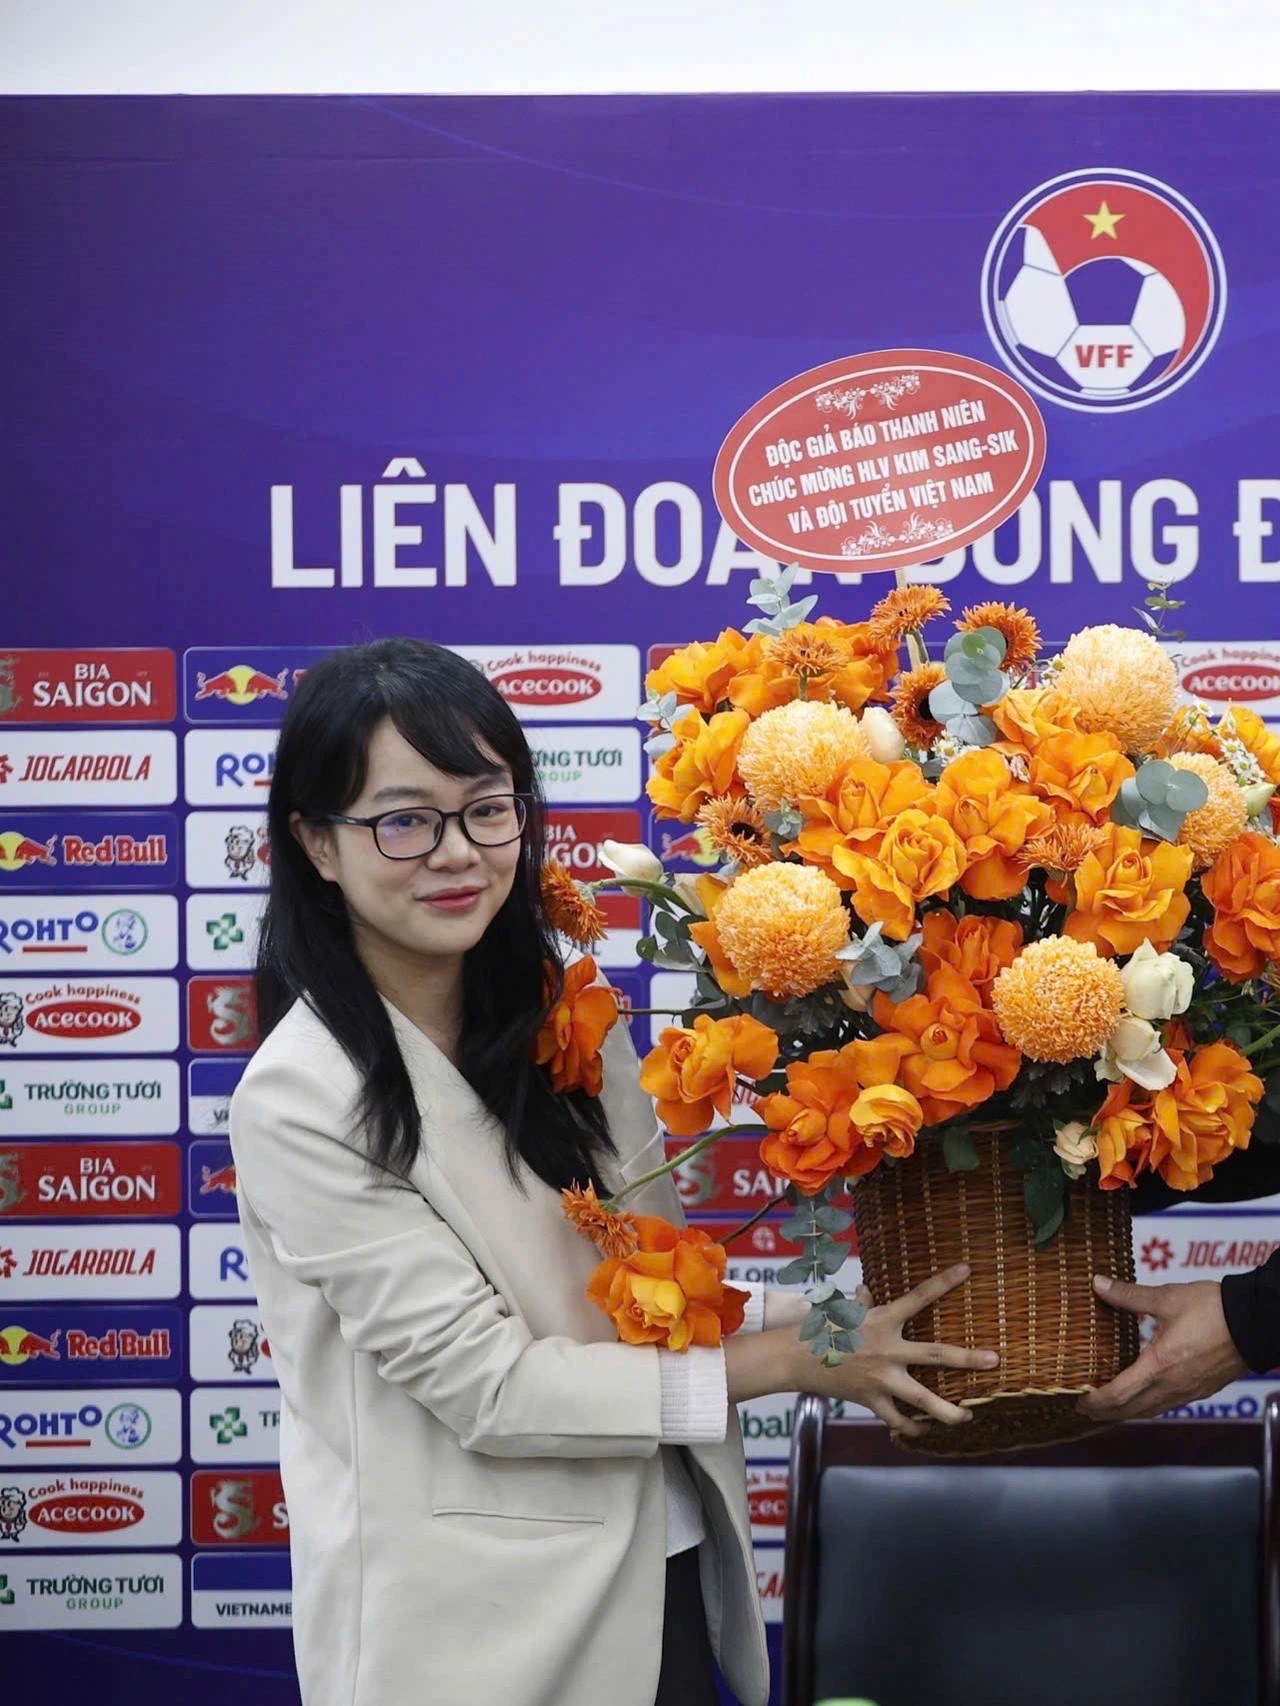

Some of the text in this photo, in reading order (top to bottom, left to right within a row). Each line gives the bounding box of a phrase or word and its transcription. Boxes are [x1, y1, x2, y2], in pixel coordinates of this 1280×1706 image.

[1075, 344, 1134, 368] VFF
[765, 398, 986, 470] ĐỘC GIẢ BÁO THANH NIÊN
[748, 429, 1020, 507] CHÚC MỪNG HLV KIM SANG-SIK
[787, 471, 995, 534] VÀ ĐỘI TUYỂN VIỆT NAM
[271, 457, 518, 588] LIÊN
[487, 651, 602, 673] Cook happiness
[1180, 647, 1217, 667] Cook
[74, 663, 111, 680] BIA
[32, 681, 152, 707] SAIGON
[18, 754, 152, 782] JOGARBOLA
[574, 749, 623, 767] TƯƠI
[63, 835, 167, 865] Red Bull
[25, 983, 141, 1005] Cook happiness
[24, 1079, 161, 1101] TRƯỜNG TƯƠI
[64, 1103, 121, 1115] GROUP
[79, 1157, 115, 1174] BIA
[38, 1175, 156, 1200] SAIGON
[22, 1249, 156, 1277] JOGARBOLA
[67, 1329, 171, 1359] Red Bull
[28, 1478, 145, 1500] Cook happiness
[26, 1573, 164, 1595] TRƯỜNG TƯƠI
[66, 1597, 124, 1610] GROUP
